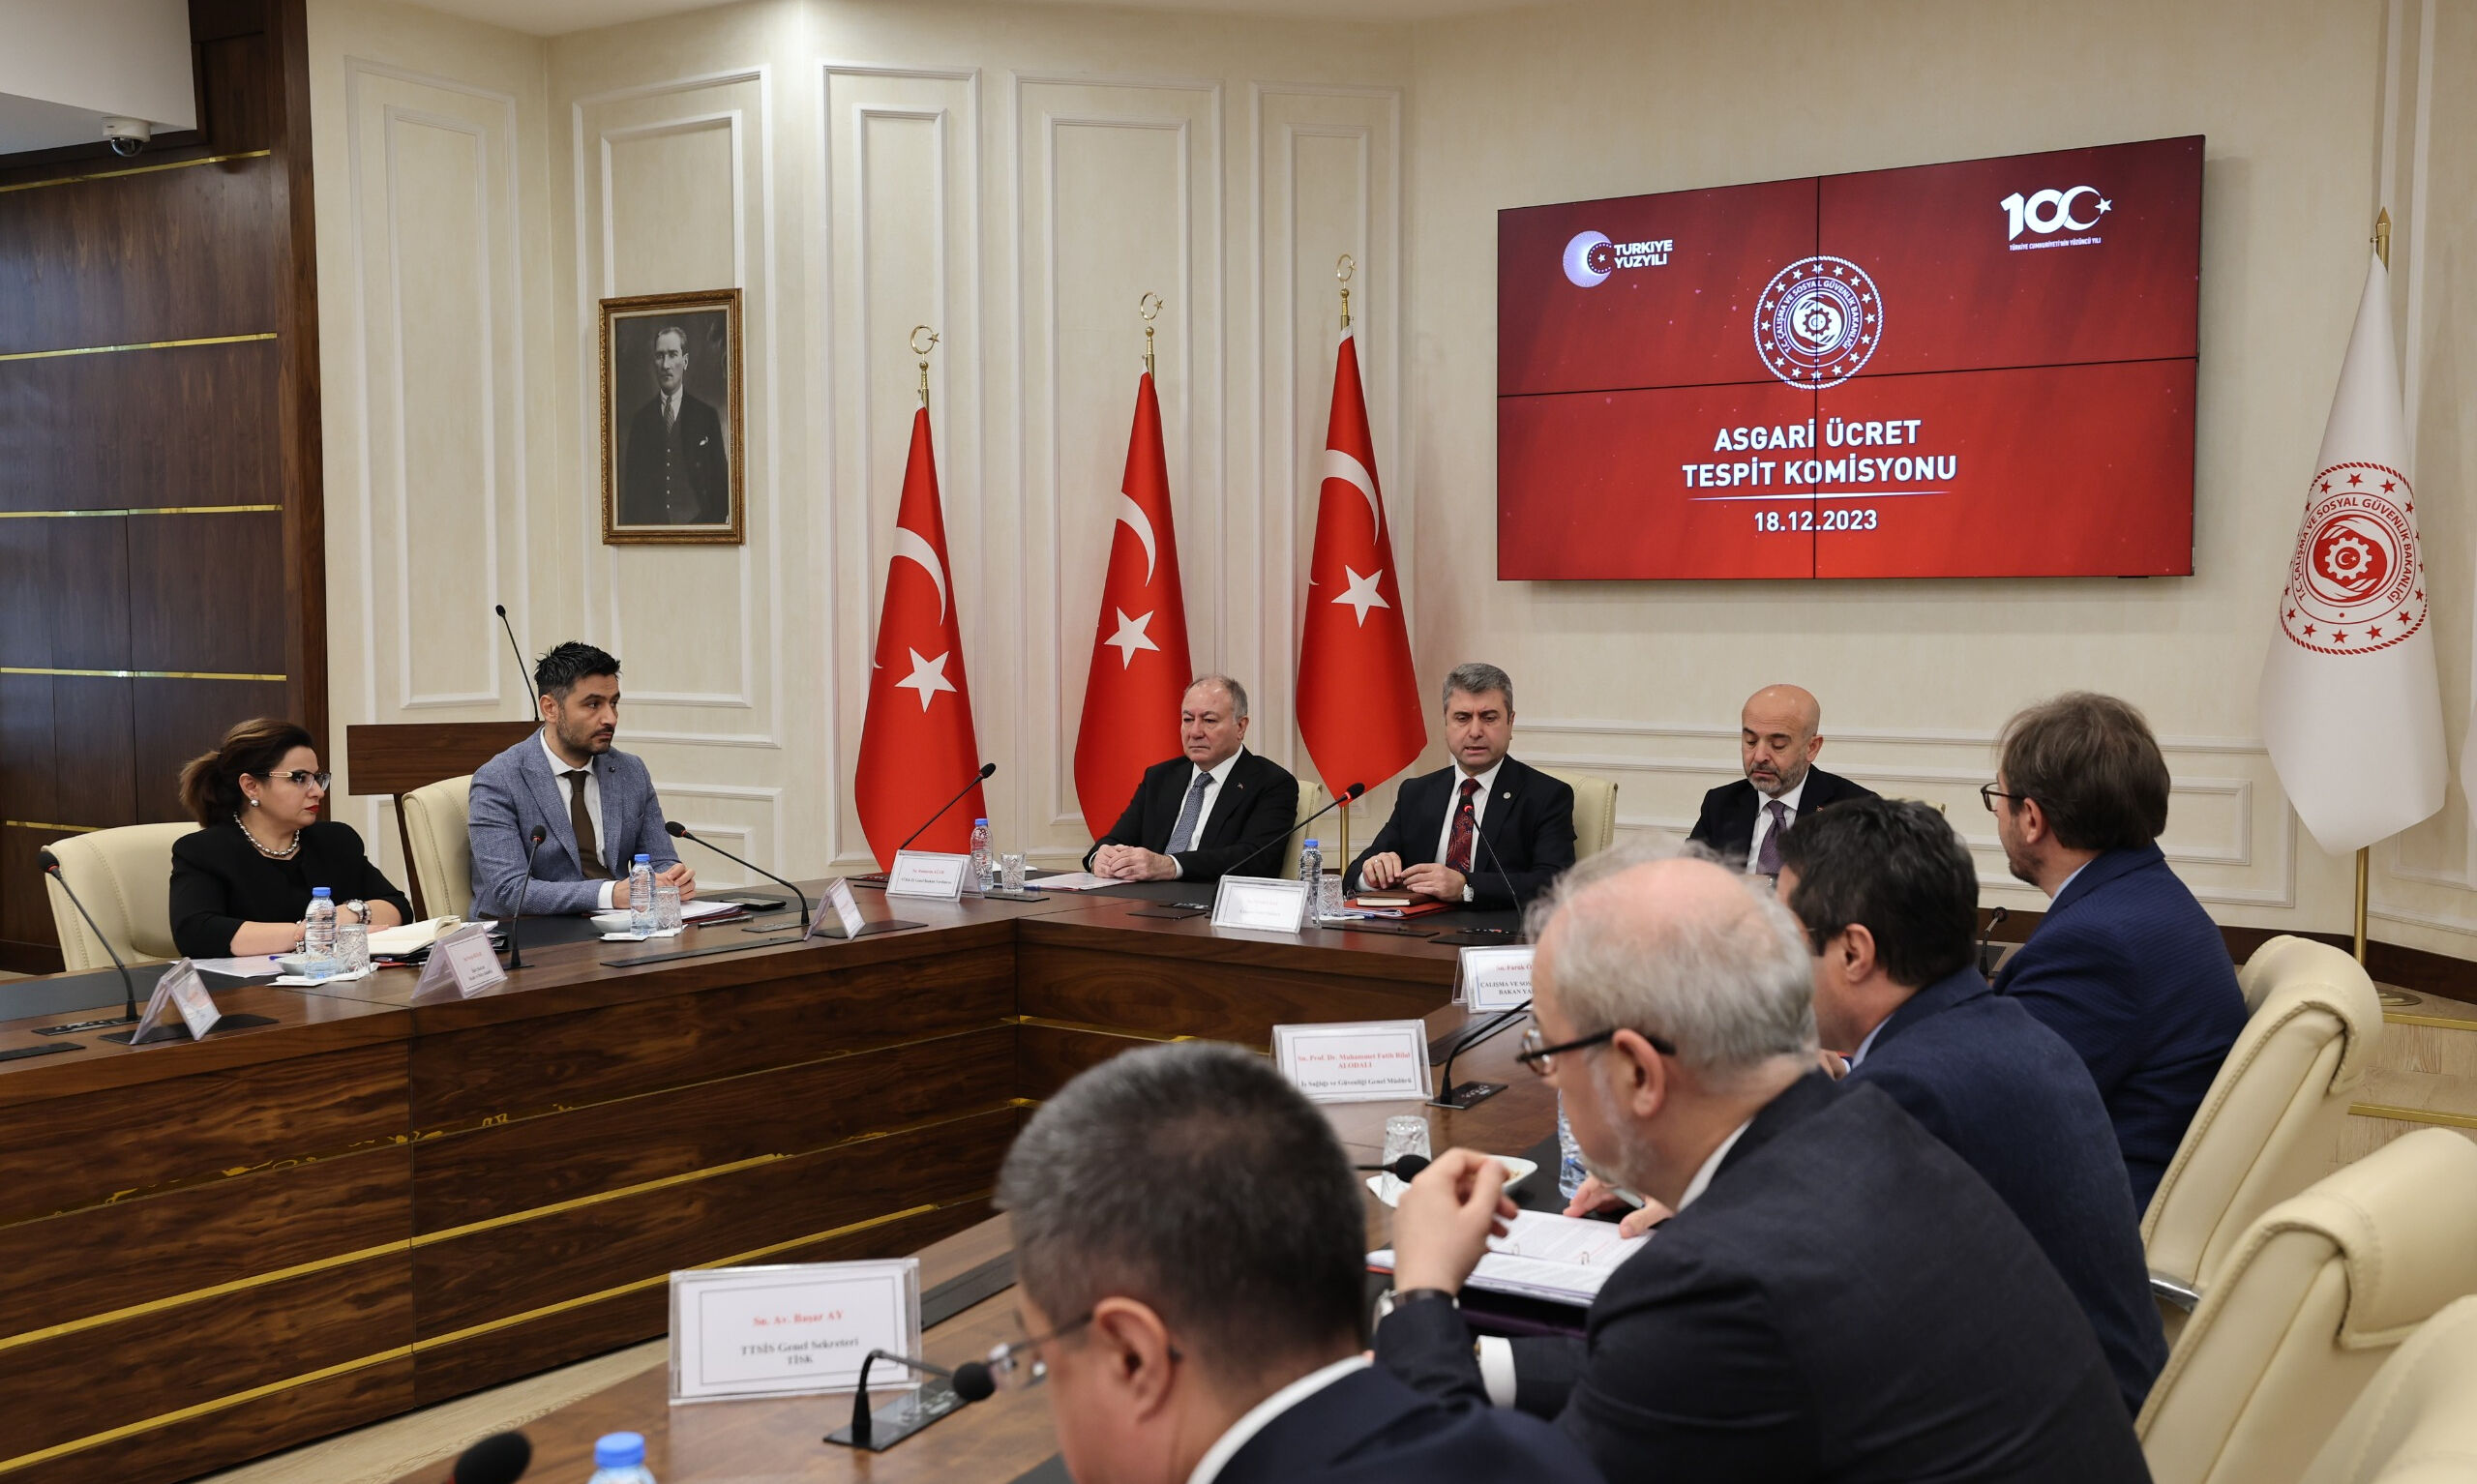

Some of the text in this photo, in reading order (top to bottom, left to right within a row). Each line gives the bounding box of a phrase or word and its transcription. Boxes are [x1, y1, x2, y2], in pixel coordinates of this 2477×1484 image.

[2000, 185, 2102, 241] 100
[1783, 293, 1795, 305] VE
[1792, 280, 1822, 297] SOSYAL
[1823, 280, 1856, 307] GÜVENLİK
[1841, 306, 1860, 350] BAKANLIĞI
[1714, 417, 1922, 452] ASGARİ ÜCRET
[1682, 453, 1957, 488] TESPİT KOMİSYONU
[1754, 509, 1878, 532] 18.12.2023
[2294, 531, 2310, 581] ÇALIŞMA
[2306, 516, 2318, 529] VE
[2316, 497, 2359, 519] SOSYAL
[2362, 498, 2409, 542] GÜVENLİK
[2386, 543, 2413, 604] BAKANLIĞI
[778, 1340, 809, 1352] Genel
